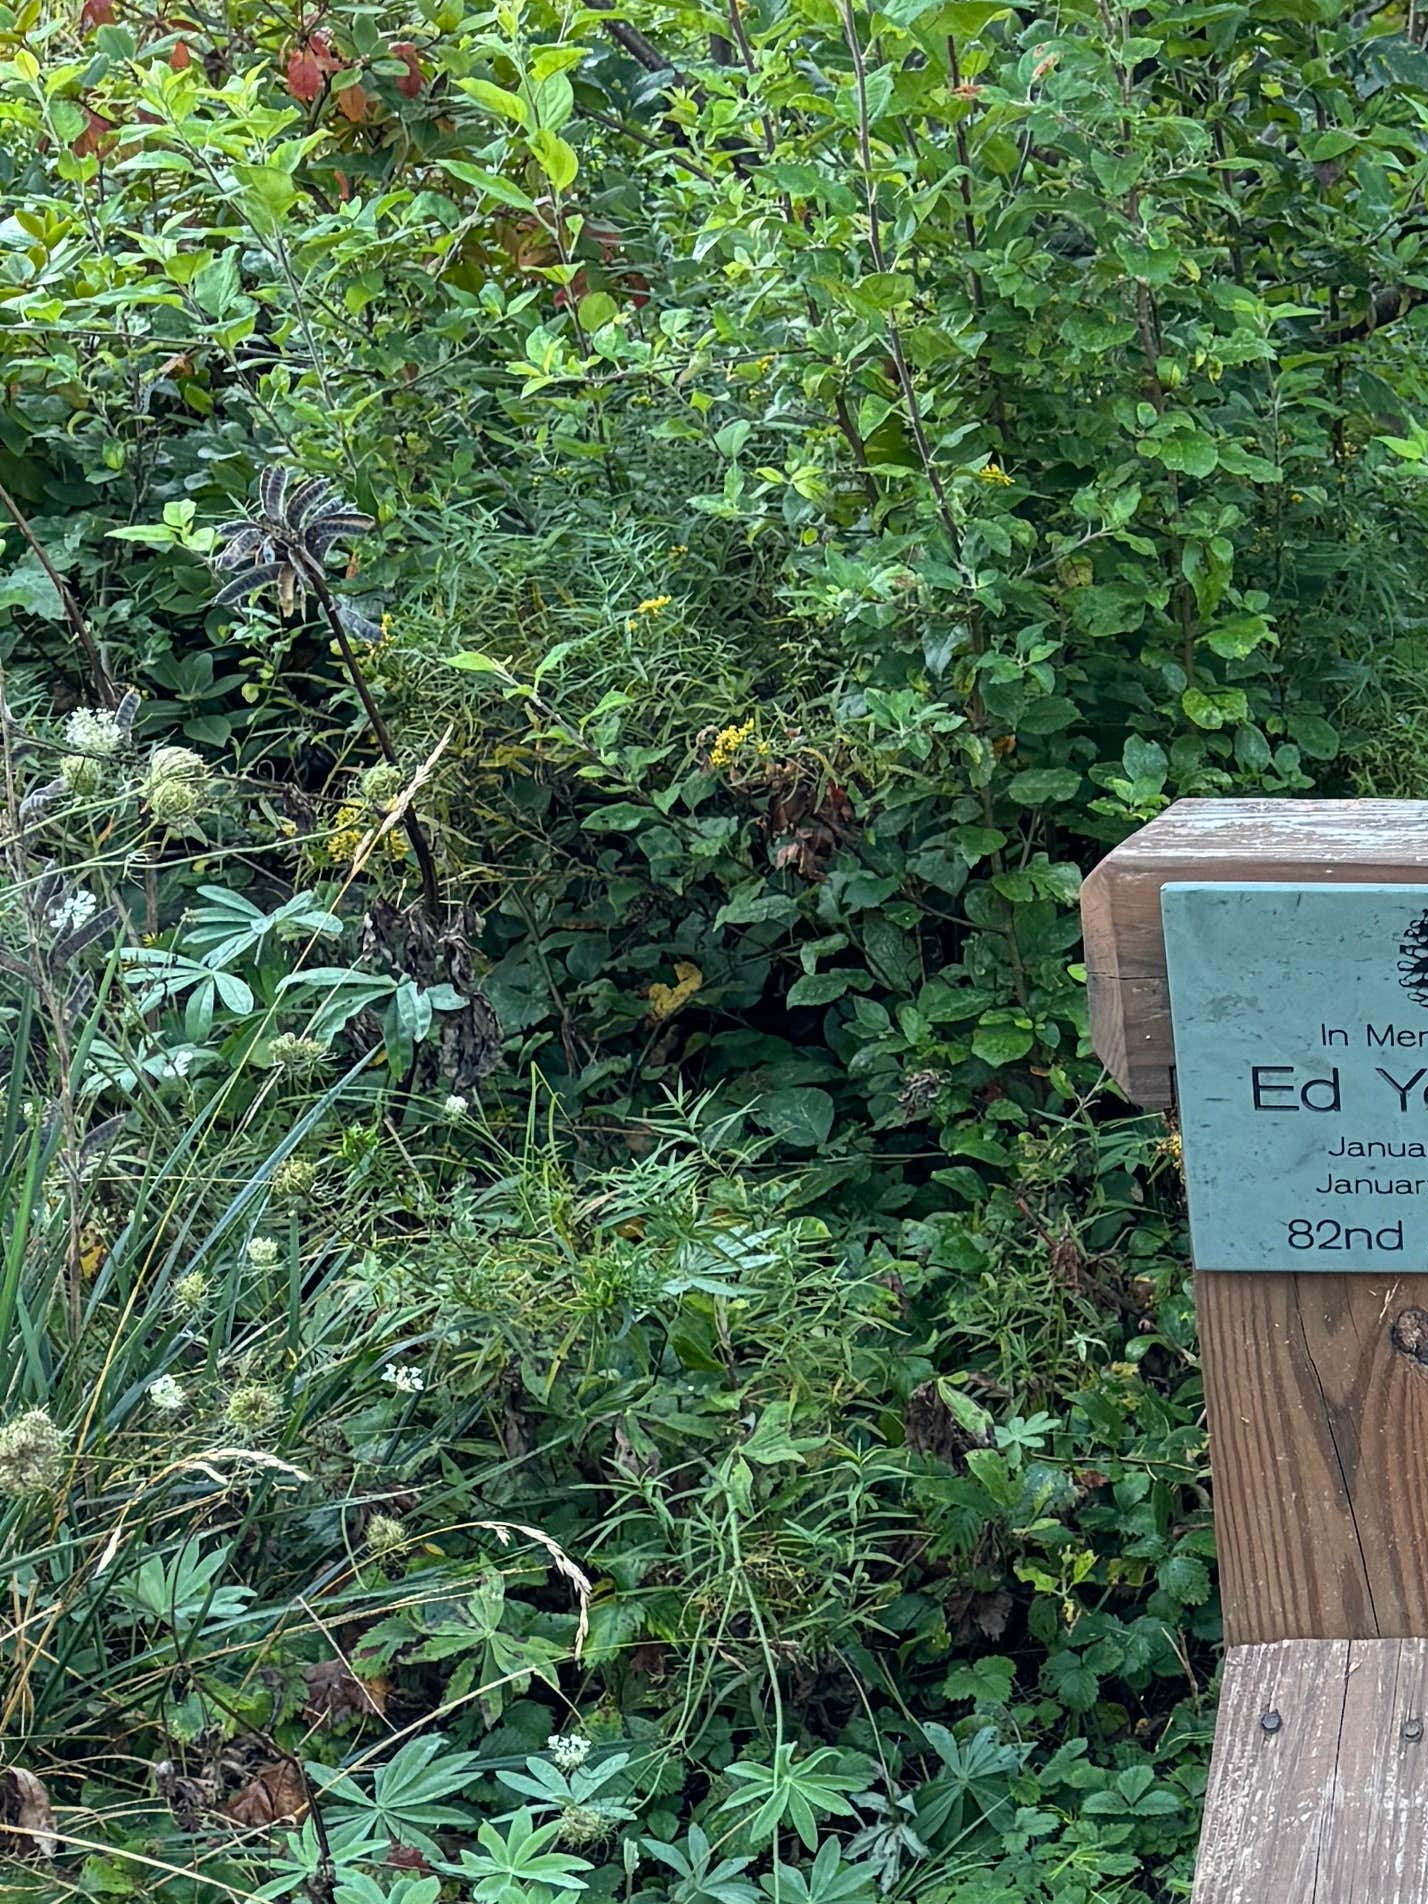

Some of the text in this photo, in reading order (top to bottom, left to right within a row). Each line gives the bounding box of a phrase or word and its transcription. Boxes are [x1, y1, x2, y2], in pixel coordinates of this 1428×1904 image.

[1320, 1022, 1349, 1048] In
[1250, 1066, 1342, 1113] Ed
[1286, 1219, 1404, 1253] 82nd
